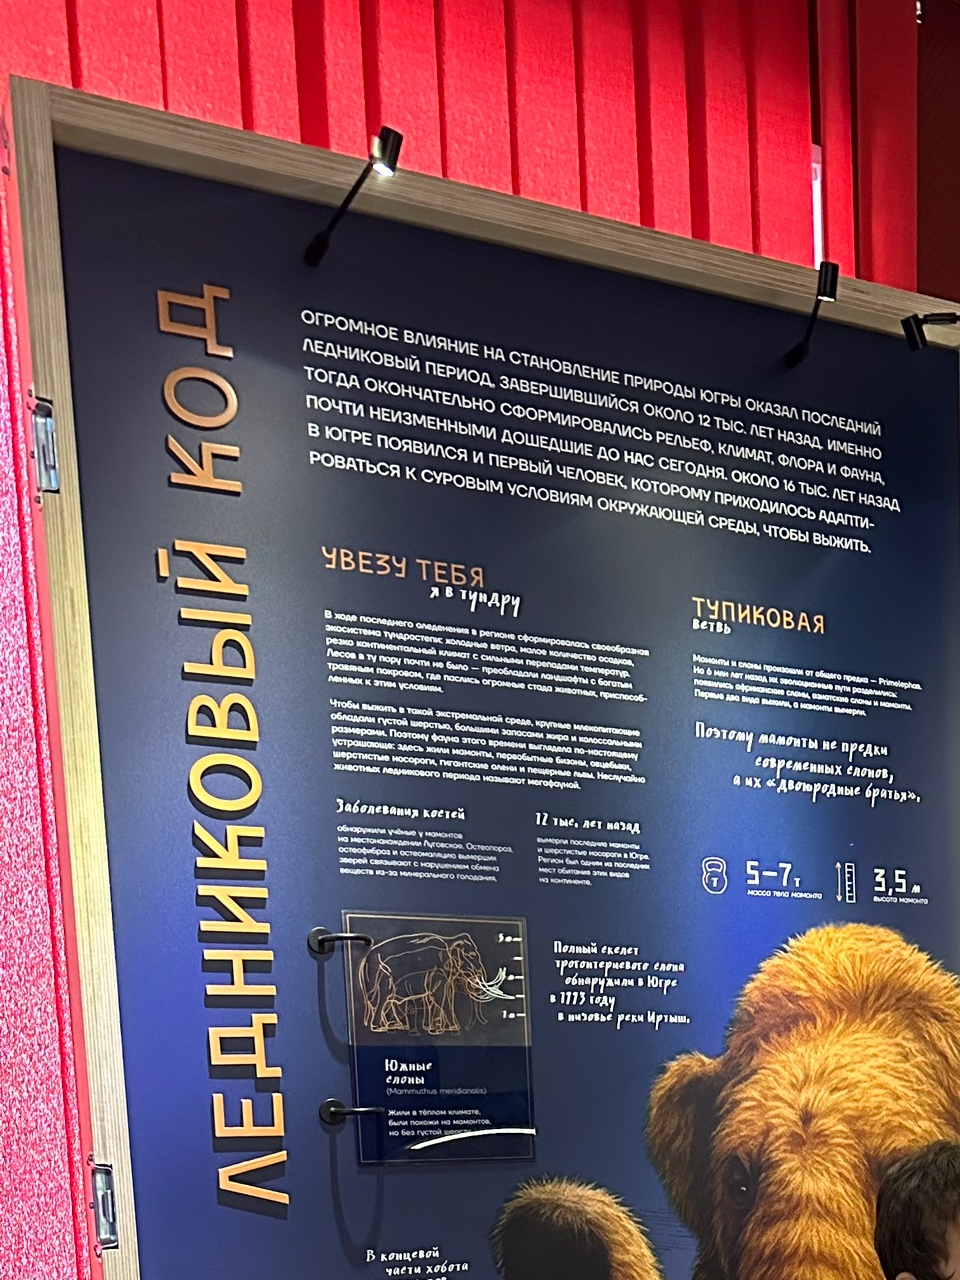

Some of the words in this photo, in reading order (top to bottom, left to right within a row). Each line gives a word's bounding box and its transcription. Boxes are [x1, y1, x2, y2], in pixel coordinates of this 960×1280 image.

[301, 309, 399, 341] ОГРОМНОЕ
[403, 329, 479, 356] ВЛИЯНИЕ
[483, 345, 505, 361] НА
[509, 350, 620, 384] СТАНОВЛЕНИЕ
[624, 373, 695, 399] ПРИРОДЫ
[700, 388, 741, 408] ЮГРЫ
[745, 398, 799, 419] ОКАЗАЛ
[801, 409, 881, 436] ПОСЛЕДНИЙ
[157, 283, 243, 494] КОД
[302, 338, 420, 372] ЛЕДНИКОВЫЙ
[425, 361, 495, 388] ПЕРИОД,
[499, 375, 639, 413] ЗАВЕРШИВШИЙСЯ
[643, 403, 694, 423] ОКОЛО
[698, 413, 711, 427] 12
[713, 416, 746, 434] ТЫС.
[750, 423, 774, 438] ЛЕТ
[777, 428, 823, 450] НАЗАД.
[827, 438, 882, 459] ИМЕННО
[303, 365, 360, 389] ТОГДА
[364, 377, 495, 413] ОКОНЧАТЕЛЬНО
[500, 402, 652, 441] СФОРМИРОВАЛИСЬ
[656, 430, 714, 454] РЕЛЬЕФ,
[718, 442, 774, 465] КЛИМАТ,
[777, 453, 824, 473] ФЛОРА
[827, 462, 836, 475] И
[840, 465, 885, 485] ФАУНА,
[321, 546, 406, 577] УВЕЗУ
[416, 559, 483, 587] ТЕБЯ
[429, 586, 439, 598] я
[445, 586, 453, 597] в
[459, 589, 520, 617] тундру
[692, 596, 825, 634] ТУПИКОВАЯ
[692, 618, 732, 635] ветвь
[695, 721, 753, 752] Поэтому
[758, 733, 818, 749] мамонты
[822, 740, 837, 750] не
[841, 742, 887, 762] предки
[755, 756, 842, 779] современных
[733, 774, 740, 785] а
[745, 777, 761, 788] их
[336, 798, 418, 818] Заболевания
[423, 807, 465, 820] костей
[535, 812, 548, 825] 12
[582, 819, 602, 829] лет
[606, 821, 640, 834] назад
[157, 539, 290, 1204] ЛЕДНИКОВЫЙ
[873, 867, 906, 895] 3,5
[554, 940, 597, 954] Полный
[601, 945, 638, 955] скелет
[653, 962, 684, 971] слона
[564, 972, 634, 993] обнаружили
[637, 977, 643, 986] в
[647, 974, 677, 995] Югре
[550, 994, 556, 1003] в
[589, 995, 615, 1012] году
[558, 1012, 564, 1021] в
[568, 1012, 612, 1021] низовье
[616, 1013, 644, 1030] реки
[385, 1058, 432, 1071] Южные
[386, 1075, 424, 1084] слоны
[366, 1249, 375, 1262] В
[380, 1246, 439, 1261] концевой
[385, 1266, 421, 1276] части
[426, 1259, 468, 1274] хобота
